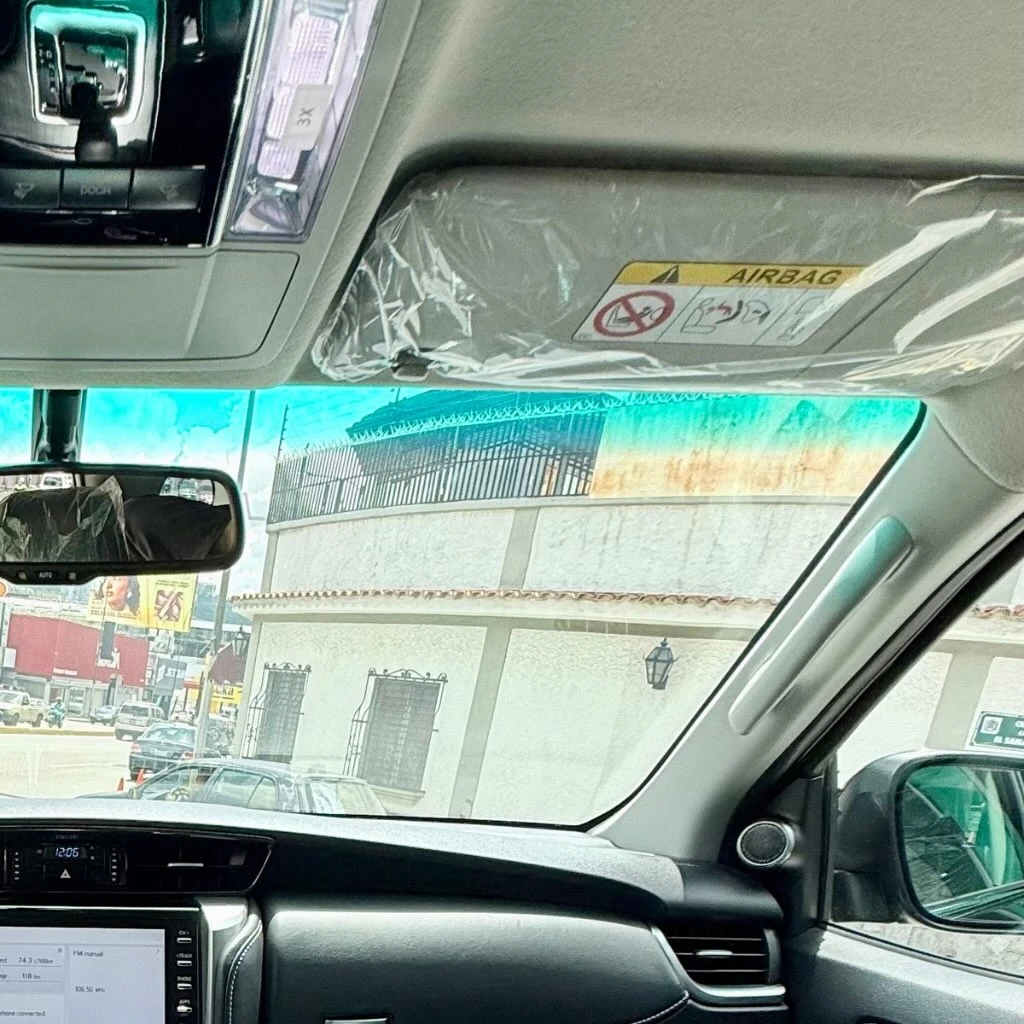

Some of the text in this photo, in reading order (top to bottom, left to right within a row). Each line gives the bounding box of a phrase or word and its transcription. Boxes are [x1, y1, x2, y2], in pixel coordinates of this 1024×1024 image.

[297, 107, 316, 127] 3X
[725, 268, 842, 285] AIRBAG
[56, 847, 79, 858] 12:06
